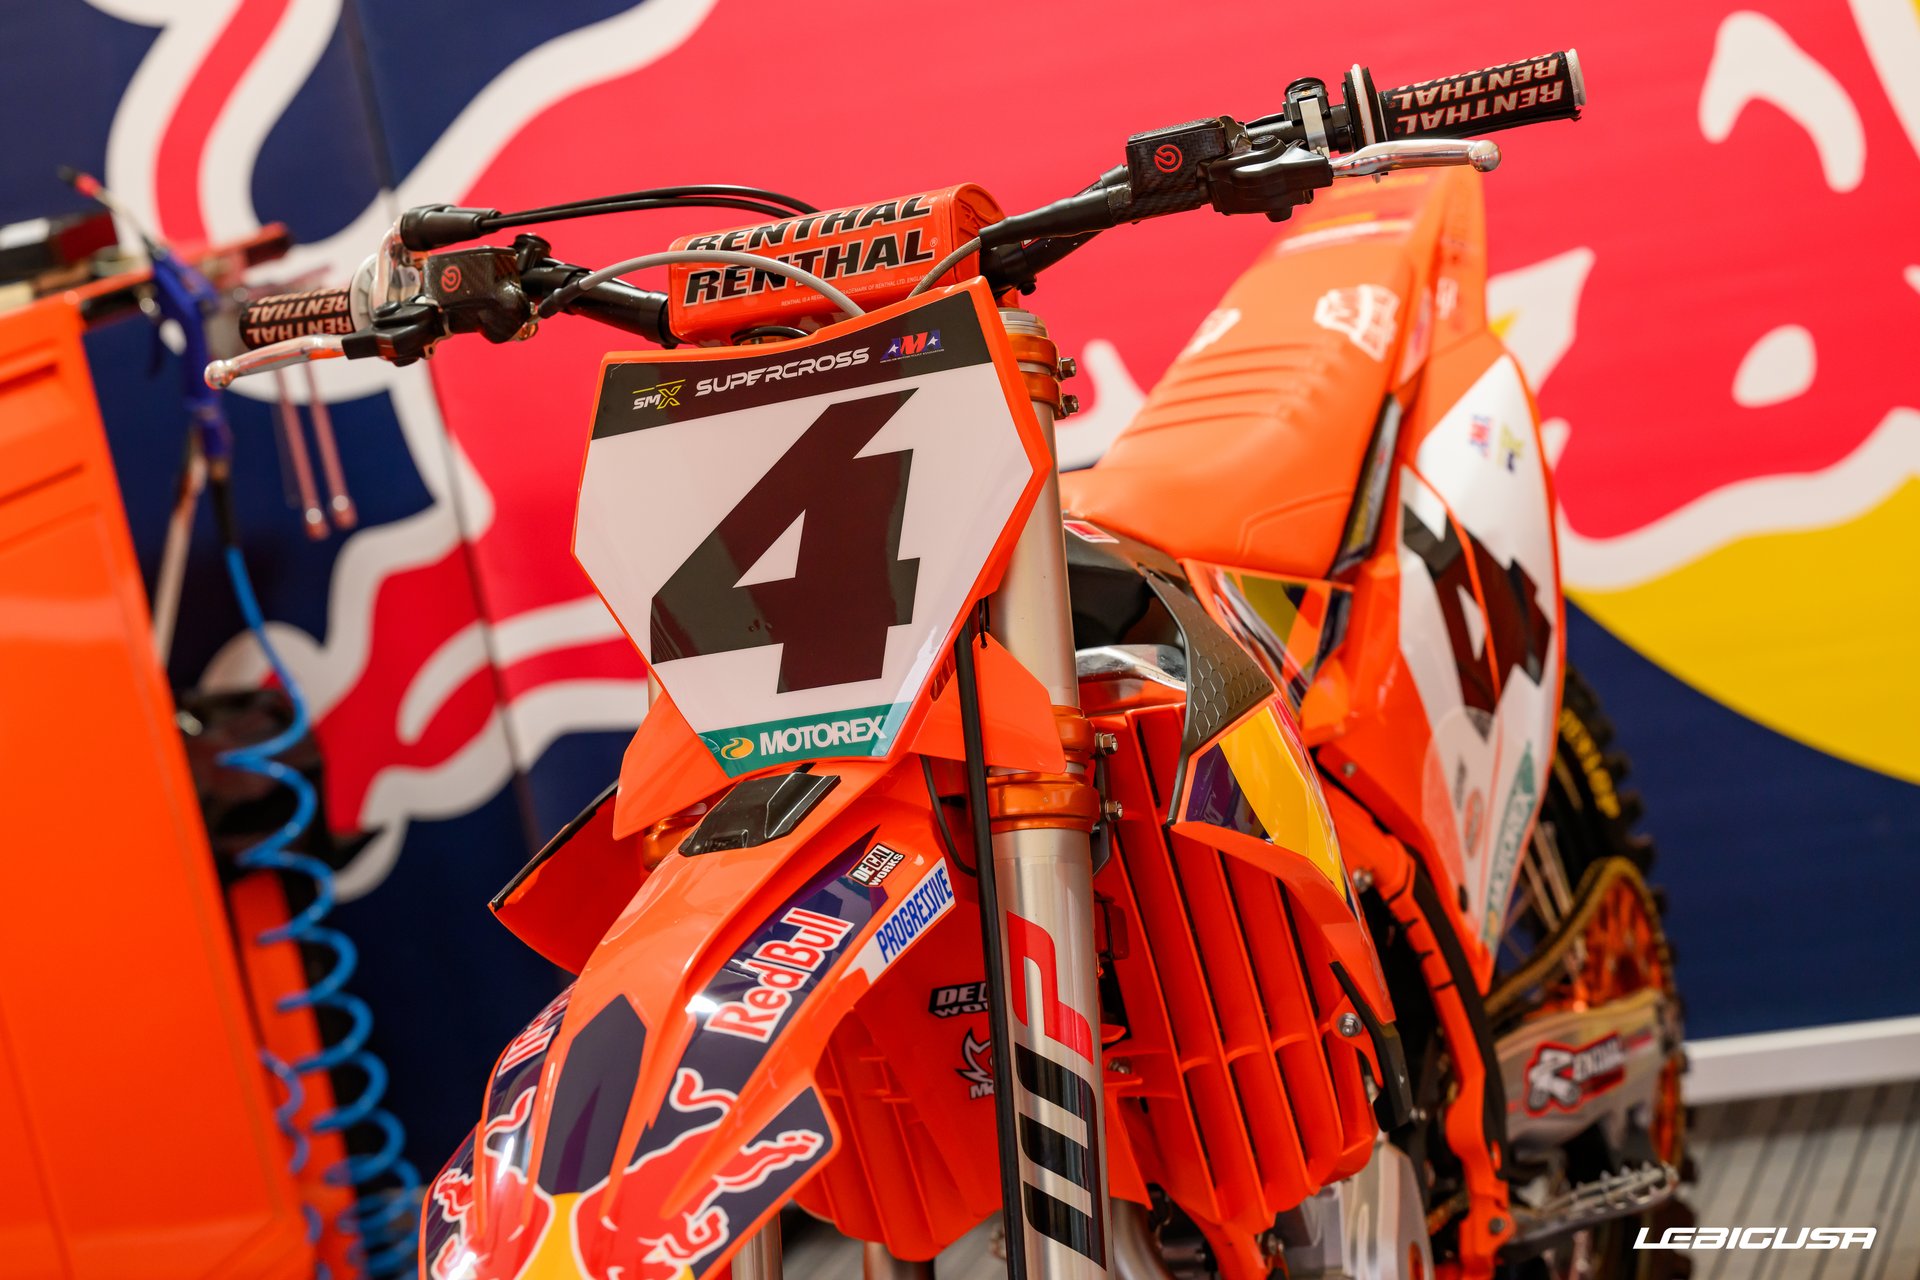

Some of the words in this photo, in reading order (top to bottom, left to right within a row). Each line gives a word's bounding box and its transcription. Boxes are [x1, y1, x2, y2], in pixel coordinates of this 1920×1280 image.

[1392, 58, 1559, 110] RENTHAL
[1397, 80, 1565, 135] RENTHAL
[685, 194, 934, 252] RENTHAL
[683, 227, 935, 307] RENTHAL
[248, 295, 349, 324] RENTHAL
[632, 385, 682, 410] SMX
[695, 347, 870, 398] SUPERCROSS
[650, 387, 920, 694] 4
[759, 715, 887, 756] MOTOREX
[868, 854, 904, 886] WORKS
[876, 868, 953, 964] PROGRESSIVE
